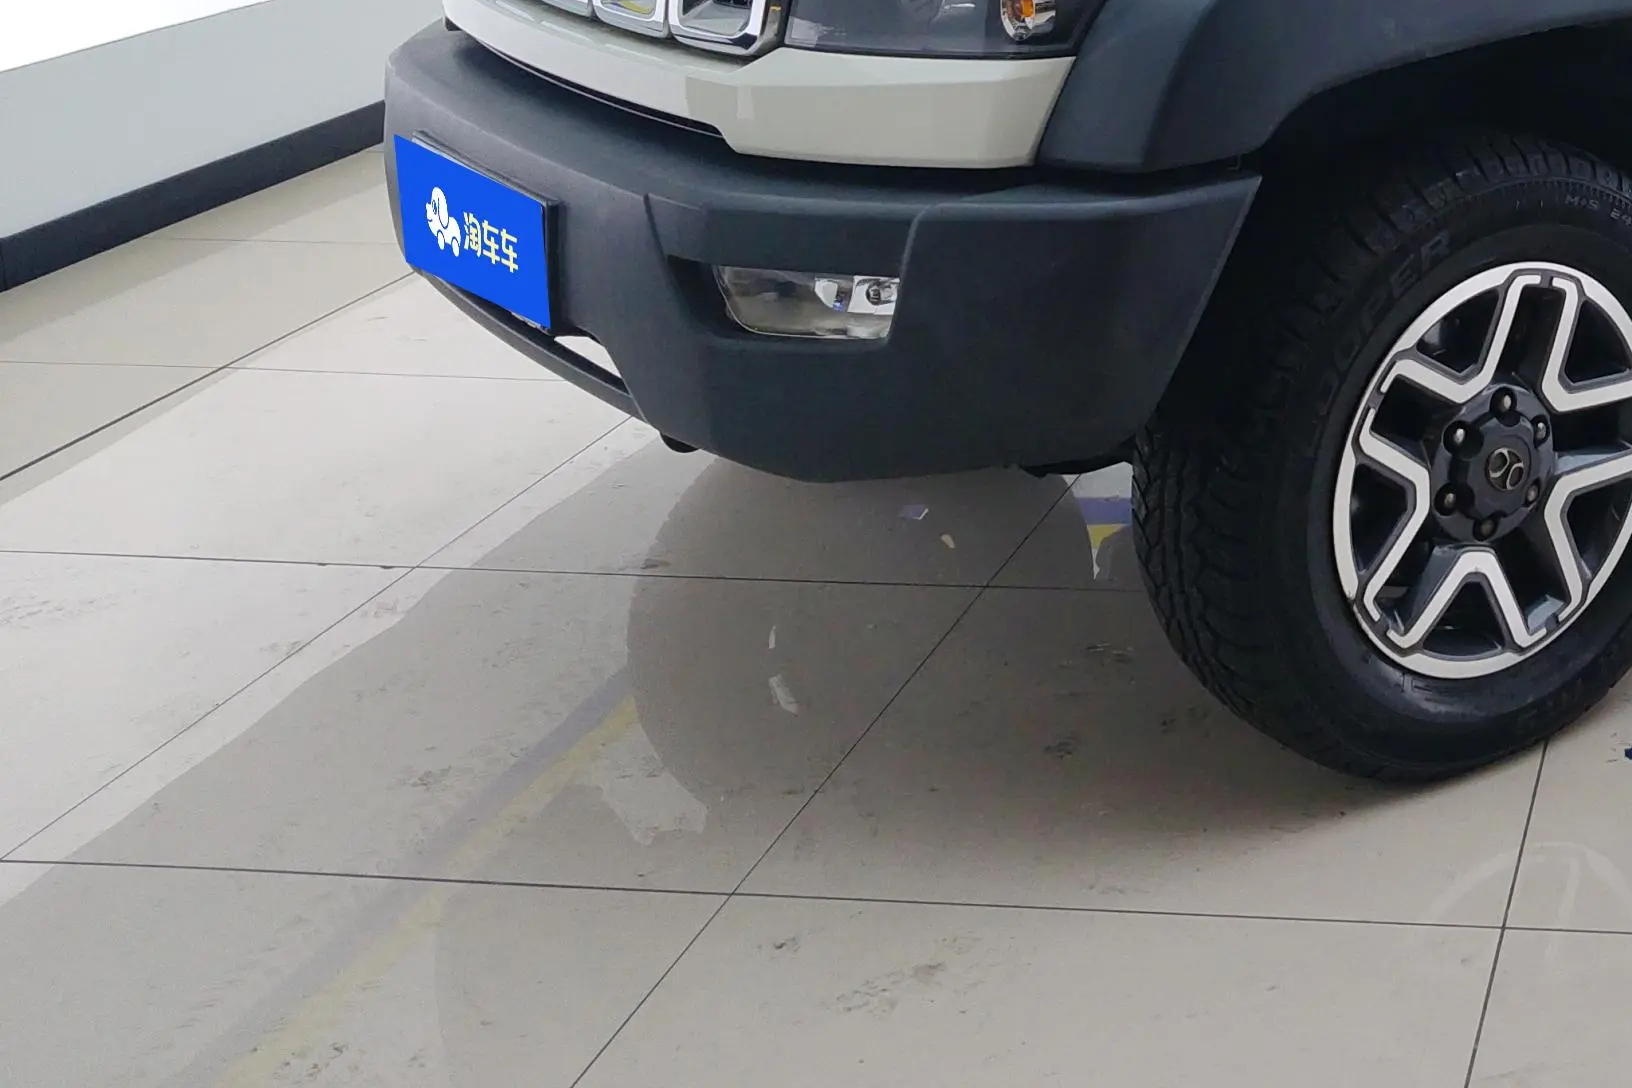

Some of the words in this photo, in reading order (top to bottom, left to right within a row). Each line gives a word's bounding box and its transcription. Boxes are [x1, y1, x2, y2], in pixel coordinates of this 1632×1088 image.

[1564, 193, 1601, 212] M+S
[463, 211, 519, 273] 淘车车
